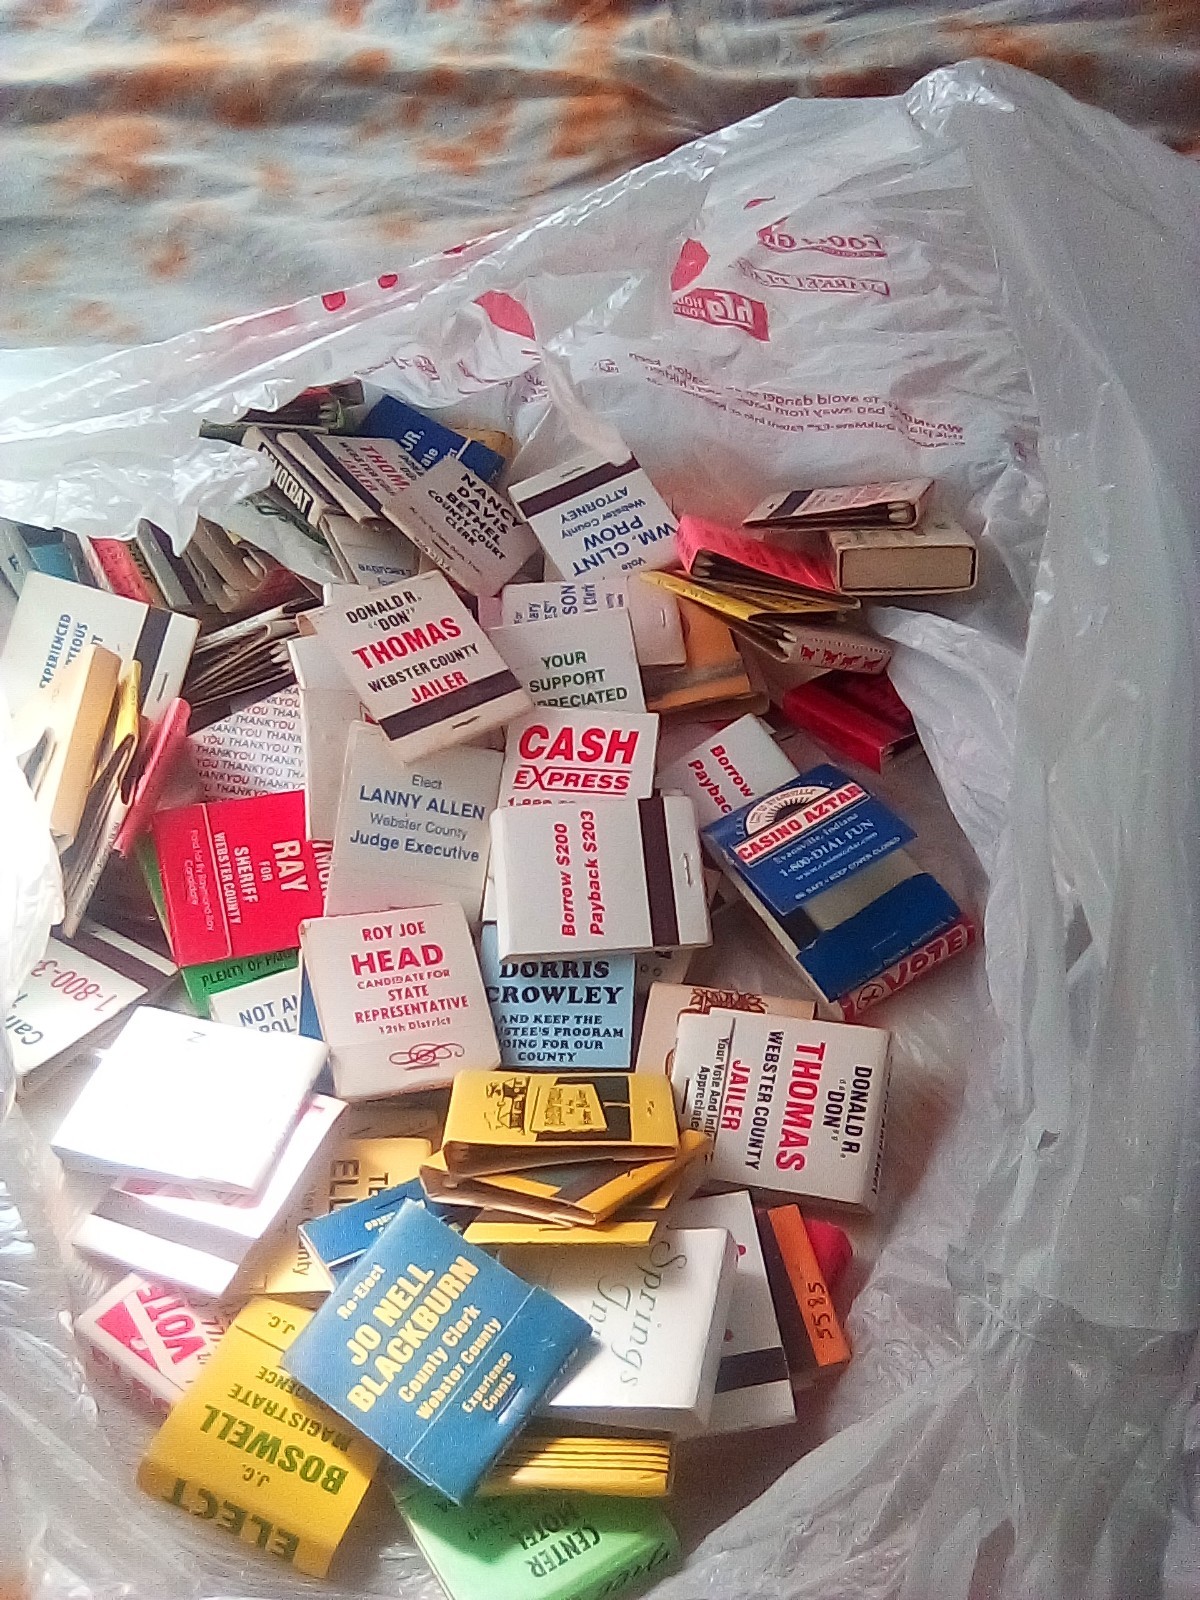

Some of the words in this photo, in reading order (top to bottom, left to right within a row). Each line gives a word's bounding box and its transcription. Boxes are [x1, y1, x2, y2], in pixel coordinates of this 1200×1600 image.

[445, 492, 501, 545] BETHEL
[456, 486, 509, 536] DAVIS
[461, 472, 524, 528] NANCY
[560, 486, 629, 525] ATTORNEY
[601, 498, 647, 521] Webster
[427, 489, 472, 530] COUNTY
[469, 527, 506, 560] COURT
[445, 516, 478, 546] CLERK
[561, 515, 601, 539] County
[583, 515, 645, 551] PROW
[632, 522, 676, 546] WM.
[572, 543, 631, 577] CLINT
[621, 557, 647, 571] Vote
[346, 594, 402, 624] DONALD
[401, 590, 422, 608] R.
[351, 616, 462, 671] THOMAS
[541, 650, 587, 669] YOUR
[367, 661, 431, 693] WEBSTER
[430, 642, 481, 672] COUNTY
[411, 671, 469, 704] JAILER
[529, 669, 605, 693] SUPPORT
[519, 725, 639, 764] CASH
[412, 774, 443, 790] Elect
[513, 765, 631, 793] EXPRESS
[688, 759, 733, 814] Paybac
[710, 744, 755, 798] Borrow
[359, 785, 422, 809] LANNY
[426, 798, 486, 821] ALLEN
[737, 819, 803, 860] CASINO
[803, 781, 864, 825] AZTAR
[350, 830, 400, 851] Judge
[404, 838, 480, 862] Executive
[370, 812, 422, 831] Webster
[425, 821, 468, 841] County
[554, 823, 569, 867] $200
[580, 810, 598, 853] $203
[214, 831, 234, 885] WEBSTER
[272, 840, 310, 891] RAY
[779, 835, 846, 878] 1-800-DIAL
[845, 818, 875, 841] FUN
[234, 846, 259, 903] SHERIFF
[258, 860, 274, 882] FOR
[222, 883, 242, 925] COUNTY
[561, 871, 576, 937] Borrow
[584, 857, 605, 937] Payback
[362, 925, 392, 942] ROY
[399, 921, 426, 937] JOE
[202, 964, 244, 987] PLENTY
[350, 944, 444, 976] HEAD
[357, 974, 425, 990] CANDIDATE
[426, 969, 451, 982] FOR
[499, 961, 610, 979] DORRIS
[885, 930, 968, 991] VOTE
[354, 995, 469, 1024] REPRESENTATIVE
[387, 985, 429, 1002] STATE
[486, 986, 625, 1005] CROWLEY
[238, 1001, 275, 1027] NOT
[378, 1023, 406, 1035] 12th
[408, 1017, 451, 1031] District
[499, 1014, 529, 1024] AND
[533, 1014, 570, 1025] KEEP
[574, 1014, 603, 1025] THE
[553, 1027, 624, 1038] PROGRAM
[501, 1039, 538, 1050] OING
[541, 1039, 570, 1050] FOR
[574, 1039, 604, 1050] OUR
[517, 1052, 577, 1063] COUNTY
[716, 1037, 730, 1061] Your
[712, 1063, 725, 1085] Vote
[757, 1030, 785, 1102] WEBSTER
[691, 1066, 711, 1131] Appreciate
[707, 1086, 722, 1112] And
[721, 1059, 751, 1132] JAILER
[775, 1042, 827, 1172] THOMAS
[846, 1065, 873, 1138] DONALD
[745, 1106, 770, 1171] COUNTY
[840, 1141, 861, 1159] R.
[337, 1262, 387, 1321] Re-Elect
[346, 1323, 383, 1367] JO
[372, 1263, 435, 1328] NELL
[610, 1240, 688, 1387] Springs
[347, 1255, 481, 1413] BLACKBURN
[398, 1346, 449, 1403] County
[441, 1303, 482, 1349] Clerk
[416, 1363, 466, 1420] Webster
[459, 1316, 503, 1366] County
[461, 1351, 513, 1414] Experience
[481, 1371, 517, 1413] Counts
[228, 1382, 352, 1454] MAGISTRATE
[200, 1403, 349, 1496] BOSWELL
[162, 1477, 300, 1560] ELECT
[526, 1524, 602, 1578] CENTER
